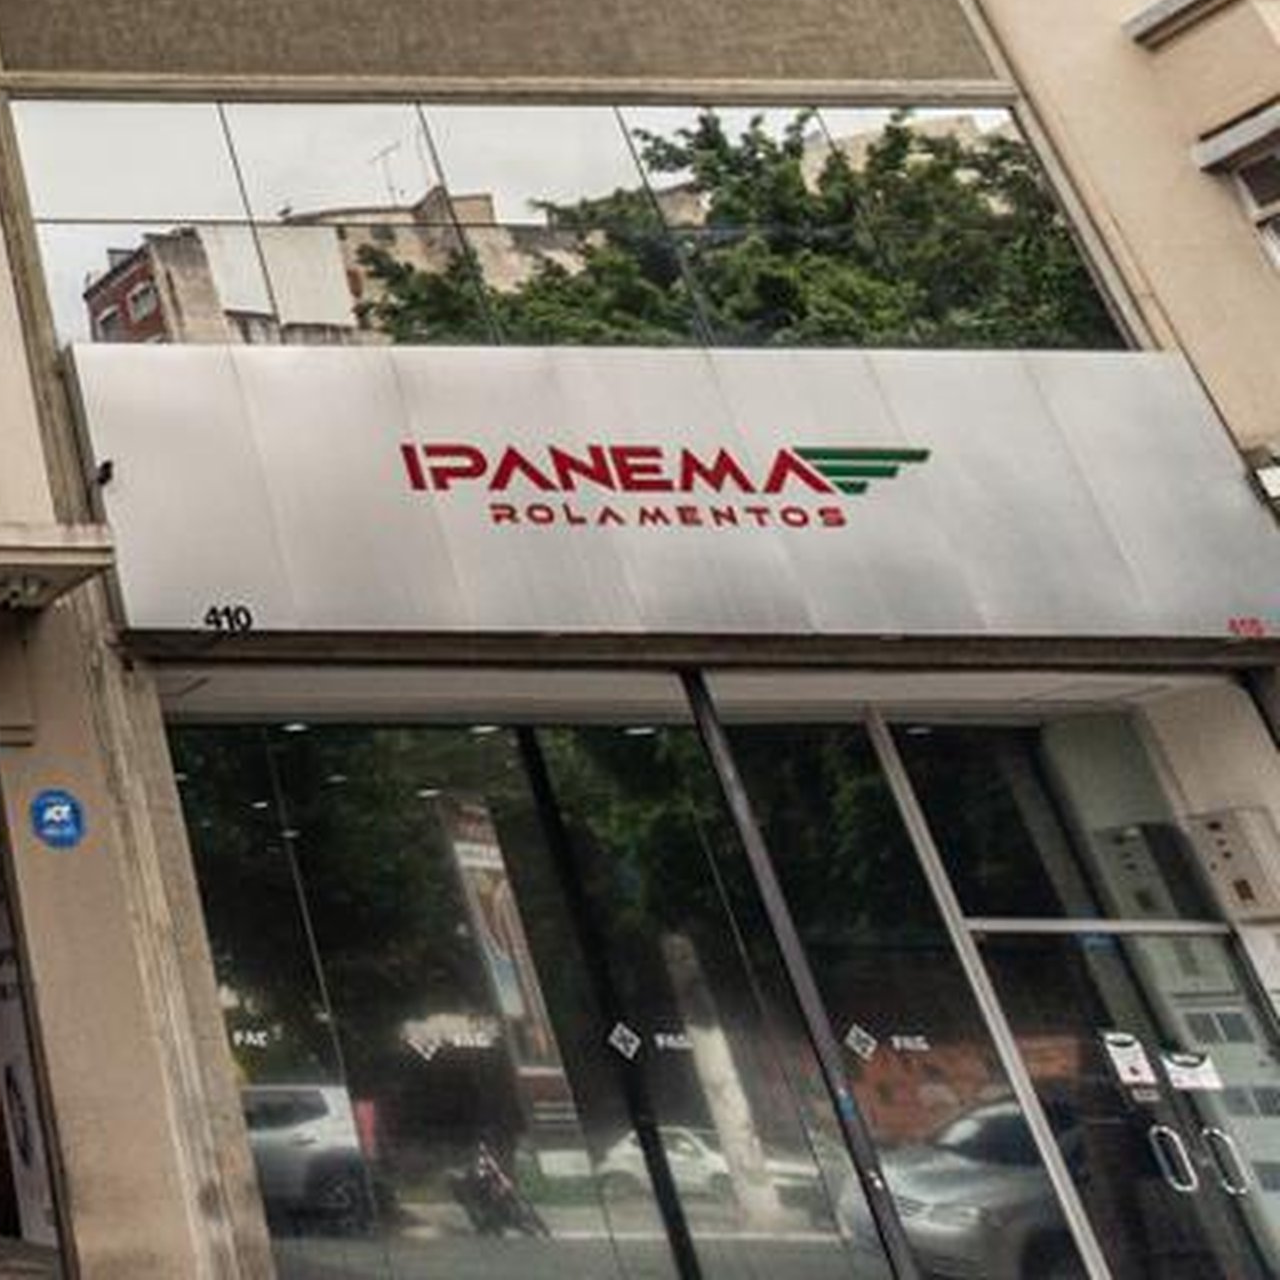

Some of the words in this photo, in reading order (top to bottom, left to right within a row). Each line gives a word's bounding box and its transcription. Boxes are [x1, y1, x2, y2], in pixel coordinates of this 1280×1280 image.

[400, 443, 836, 494] IPANEMA
[489, 502, 848, 528] ROLAMENTOS
[203, 605, 253, 632] 410
